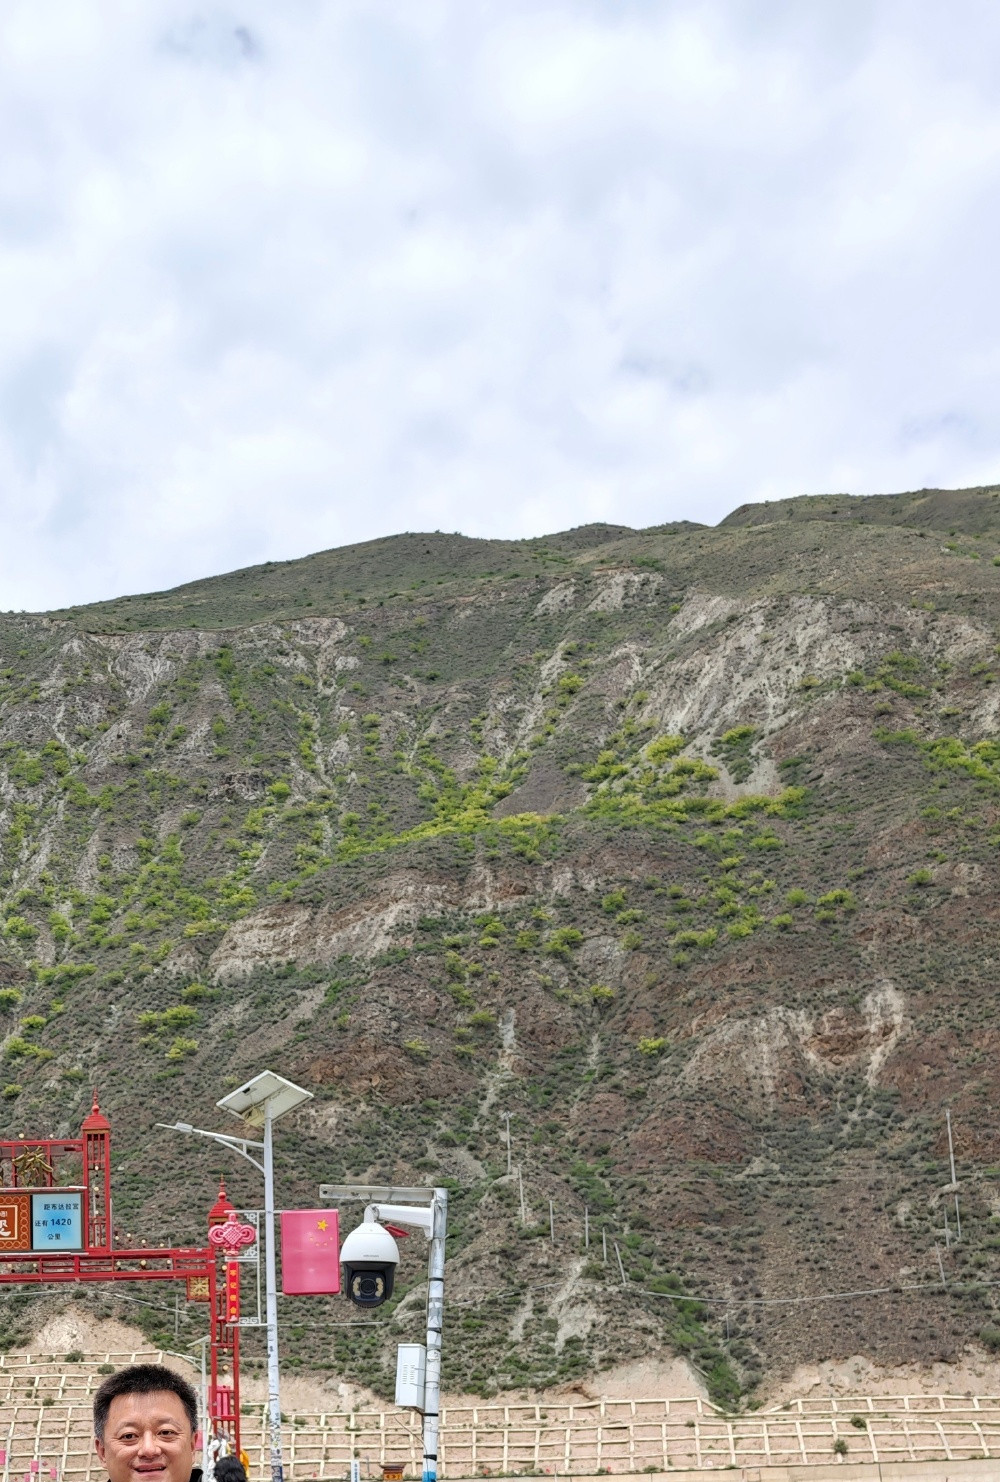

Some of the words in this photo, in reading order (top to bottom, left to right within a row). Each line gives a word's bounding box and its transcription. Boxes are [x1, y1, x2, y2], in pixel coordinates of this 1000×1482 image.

[43, 1202, 79, 1212] 距布达拉宫
[34, 1219, 49, 1228] 还有
[50, 1217, 72, 1227] 1420
[47, 1233, 62, 1241] 公里
